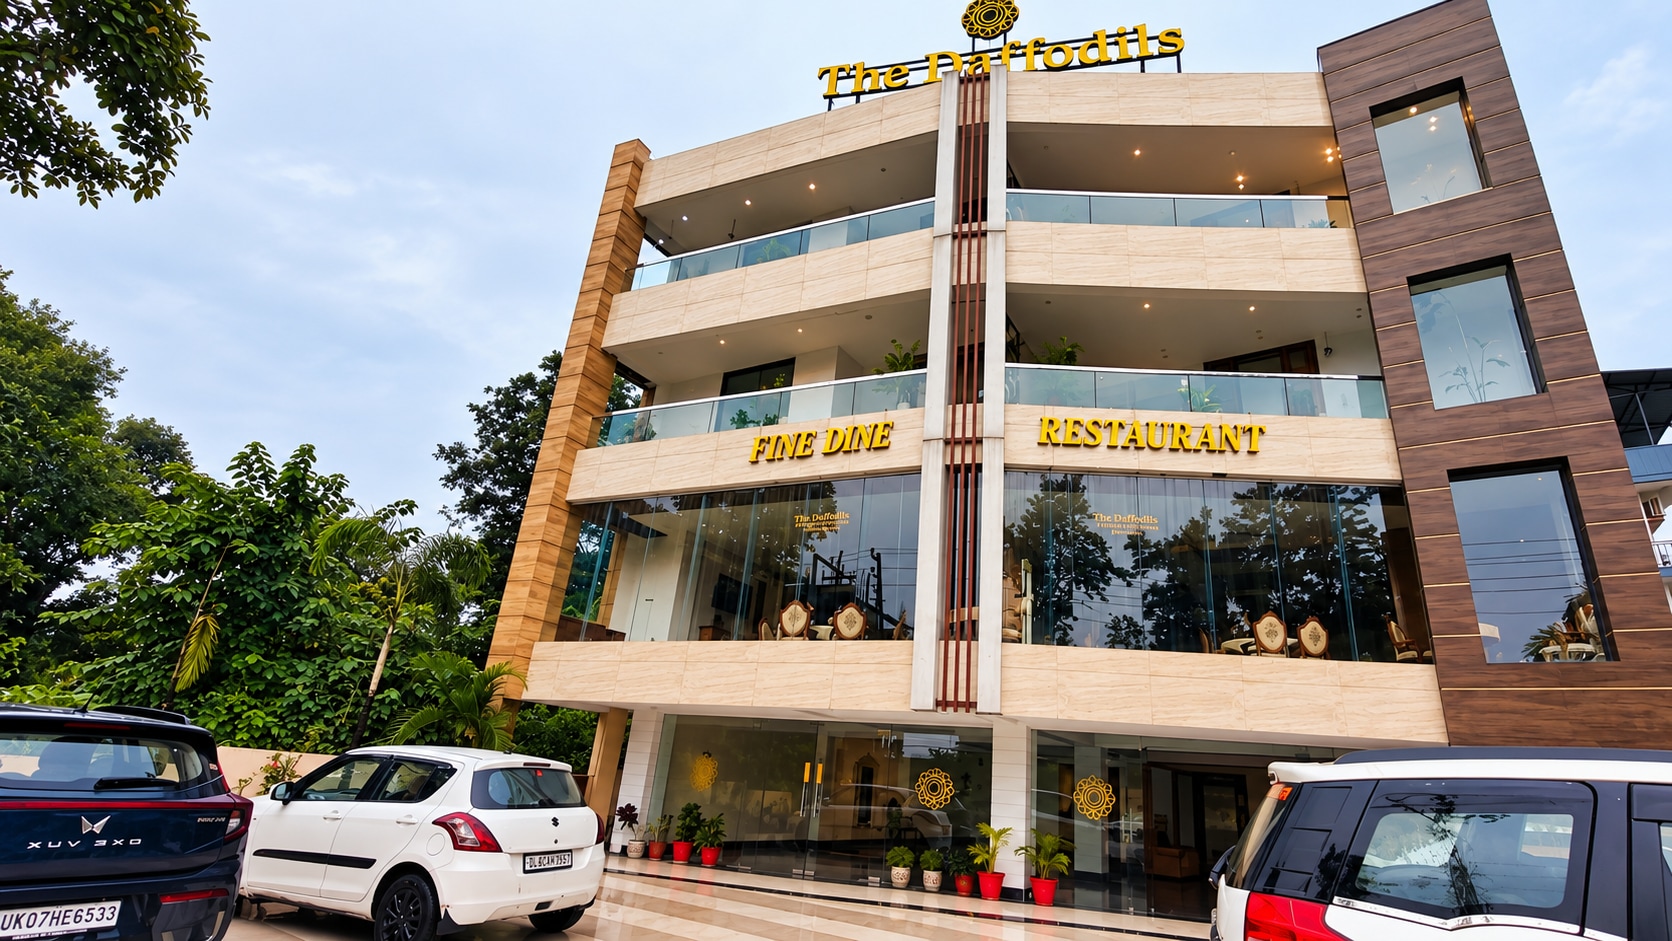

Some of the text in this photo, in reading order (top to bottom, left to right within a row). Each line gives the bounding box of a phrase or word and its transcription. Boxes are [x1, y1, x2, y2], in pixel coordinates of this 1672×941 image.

[818, 23, 1185, 97] The Daffodils
[749, 420, 894, 464] FINE DINE
[1037, 416, 1267, 454] RESTAURANT
[1092, 512, 1159, 524] The Daffodils
[27, 838, 142, 850] XUV 3XO
[0, 905, 117, 932] UK07HE6533
